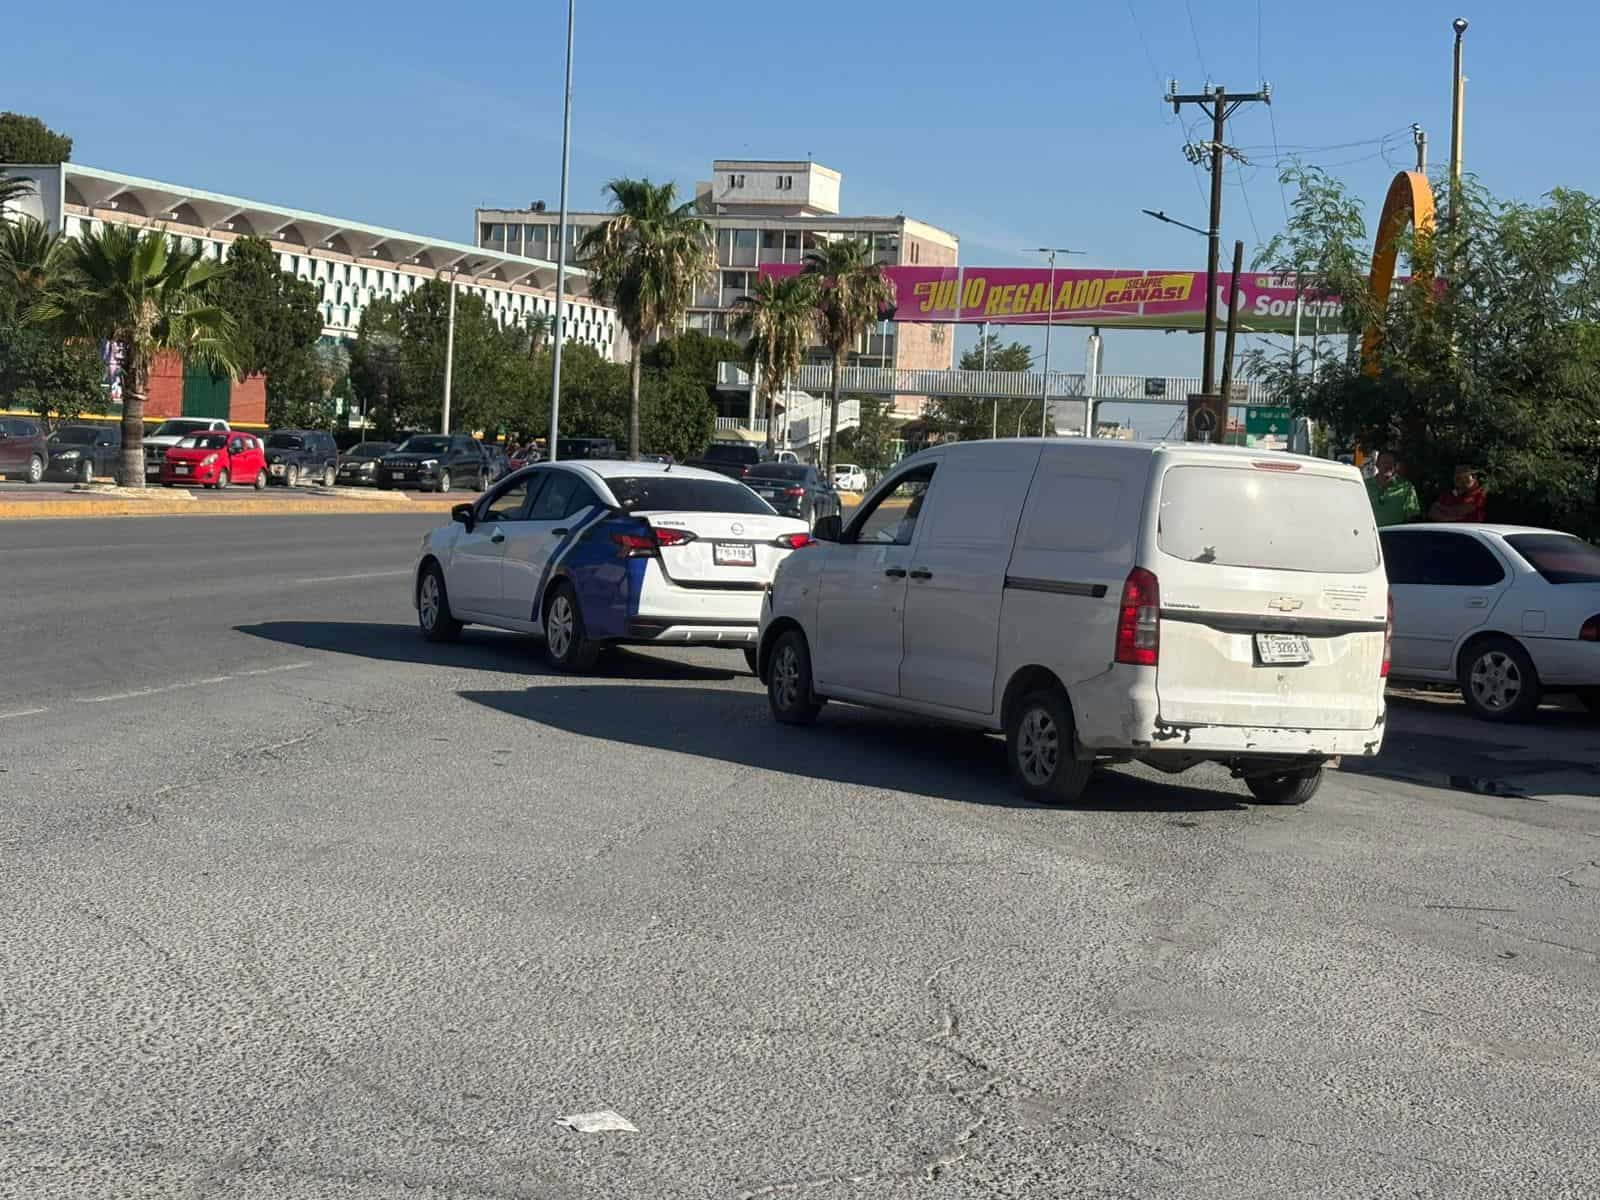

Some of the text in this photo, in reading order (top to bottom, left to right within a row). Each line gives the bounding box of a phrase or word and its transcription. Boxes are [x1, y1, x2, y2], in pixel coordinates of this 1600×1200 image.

[919, 277, 1103, 316] JULIO REGALADO
[1105, 286, 1185, 304] GANAS!
